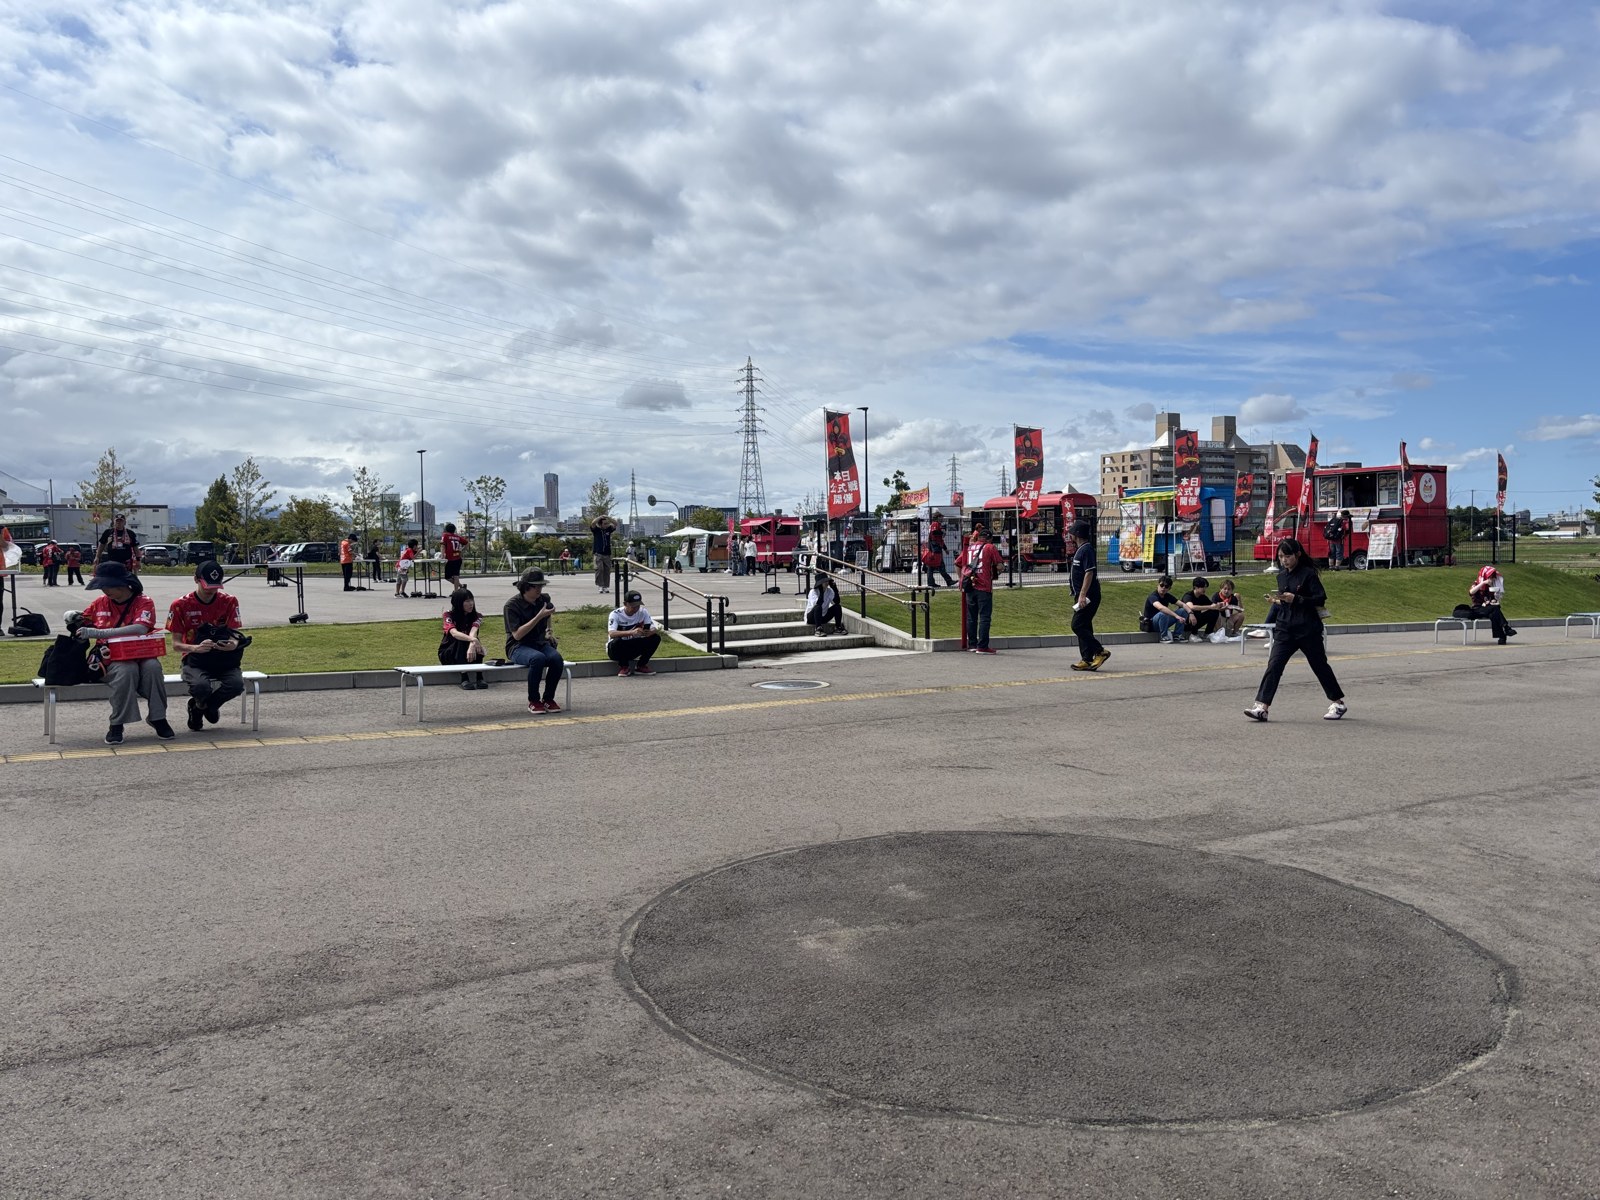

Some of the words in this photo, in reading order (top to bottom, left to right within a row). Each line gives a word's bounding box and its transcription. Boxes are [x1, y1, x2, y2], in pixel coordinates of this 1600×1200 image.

[833, 470, 850, 482] 本日
[1180, 476, 1199, 486] 本日
[830, 480, 859, 494] 公式戦
[833, 493, 853, 505] 開催
[1179, 496, 1198, 506] 開催
